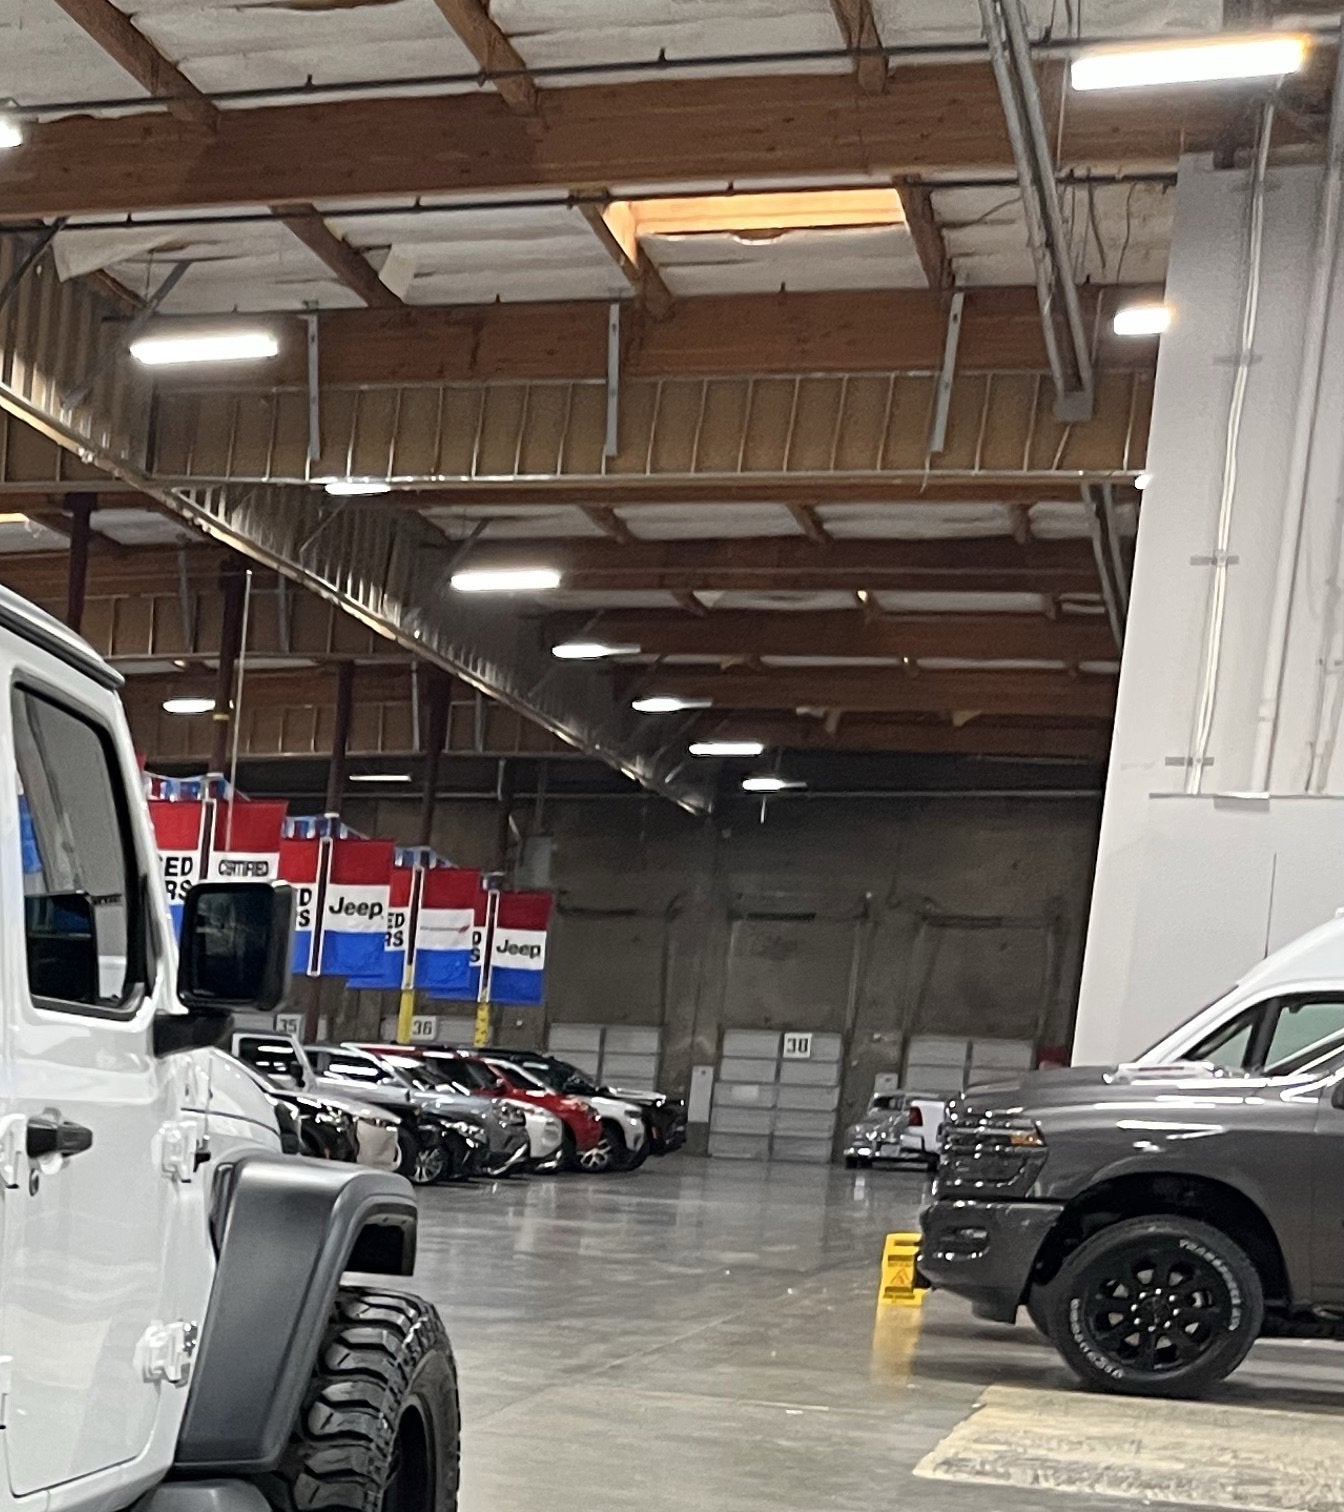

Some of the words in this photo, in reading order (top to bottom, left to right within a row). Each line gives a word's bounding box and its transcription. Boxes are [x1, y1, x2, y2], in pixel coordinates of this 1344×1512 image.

[329, 897, 383, 920] Jeep
[496, 939, 541, 960] Jeep
[279, 1018, 298, 1033] 35
[413, 1020, 433, 1036] 36
